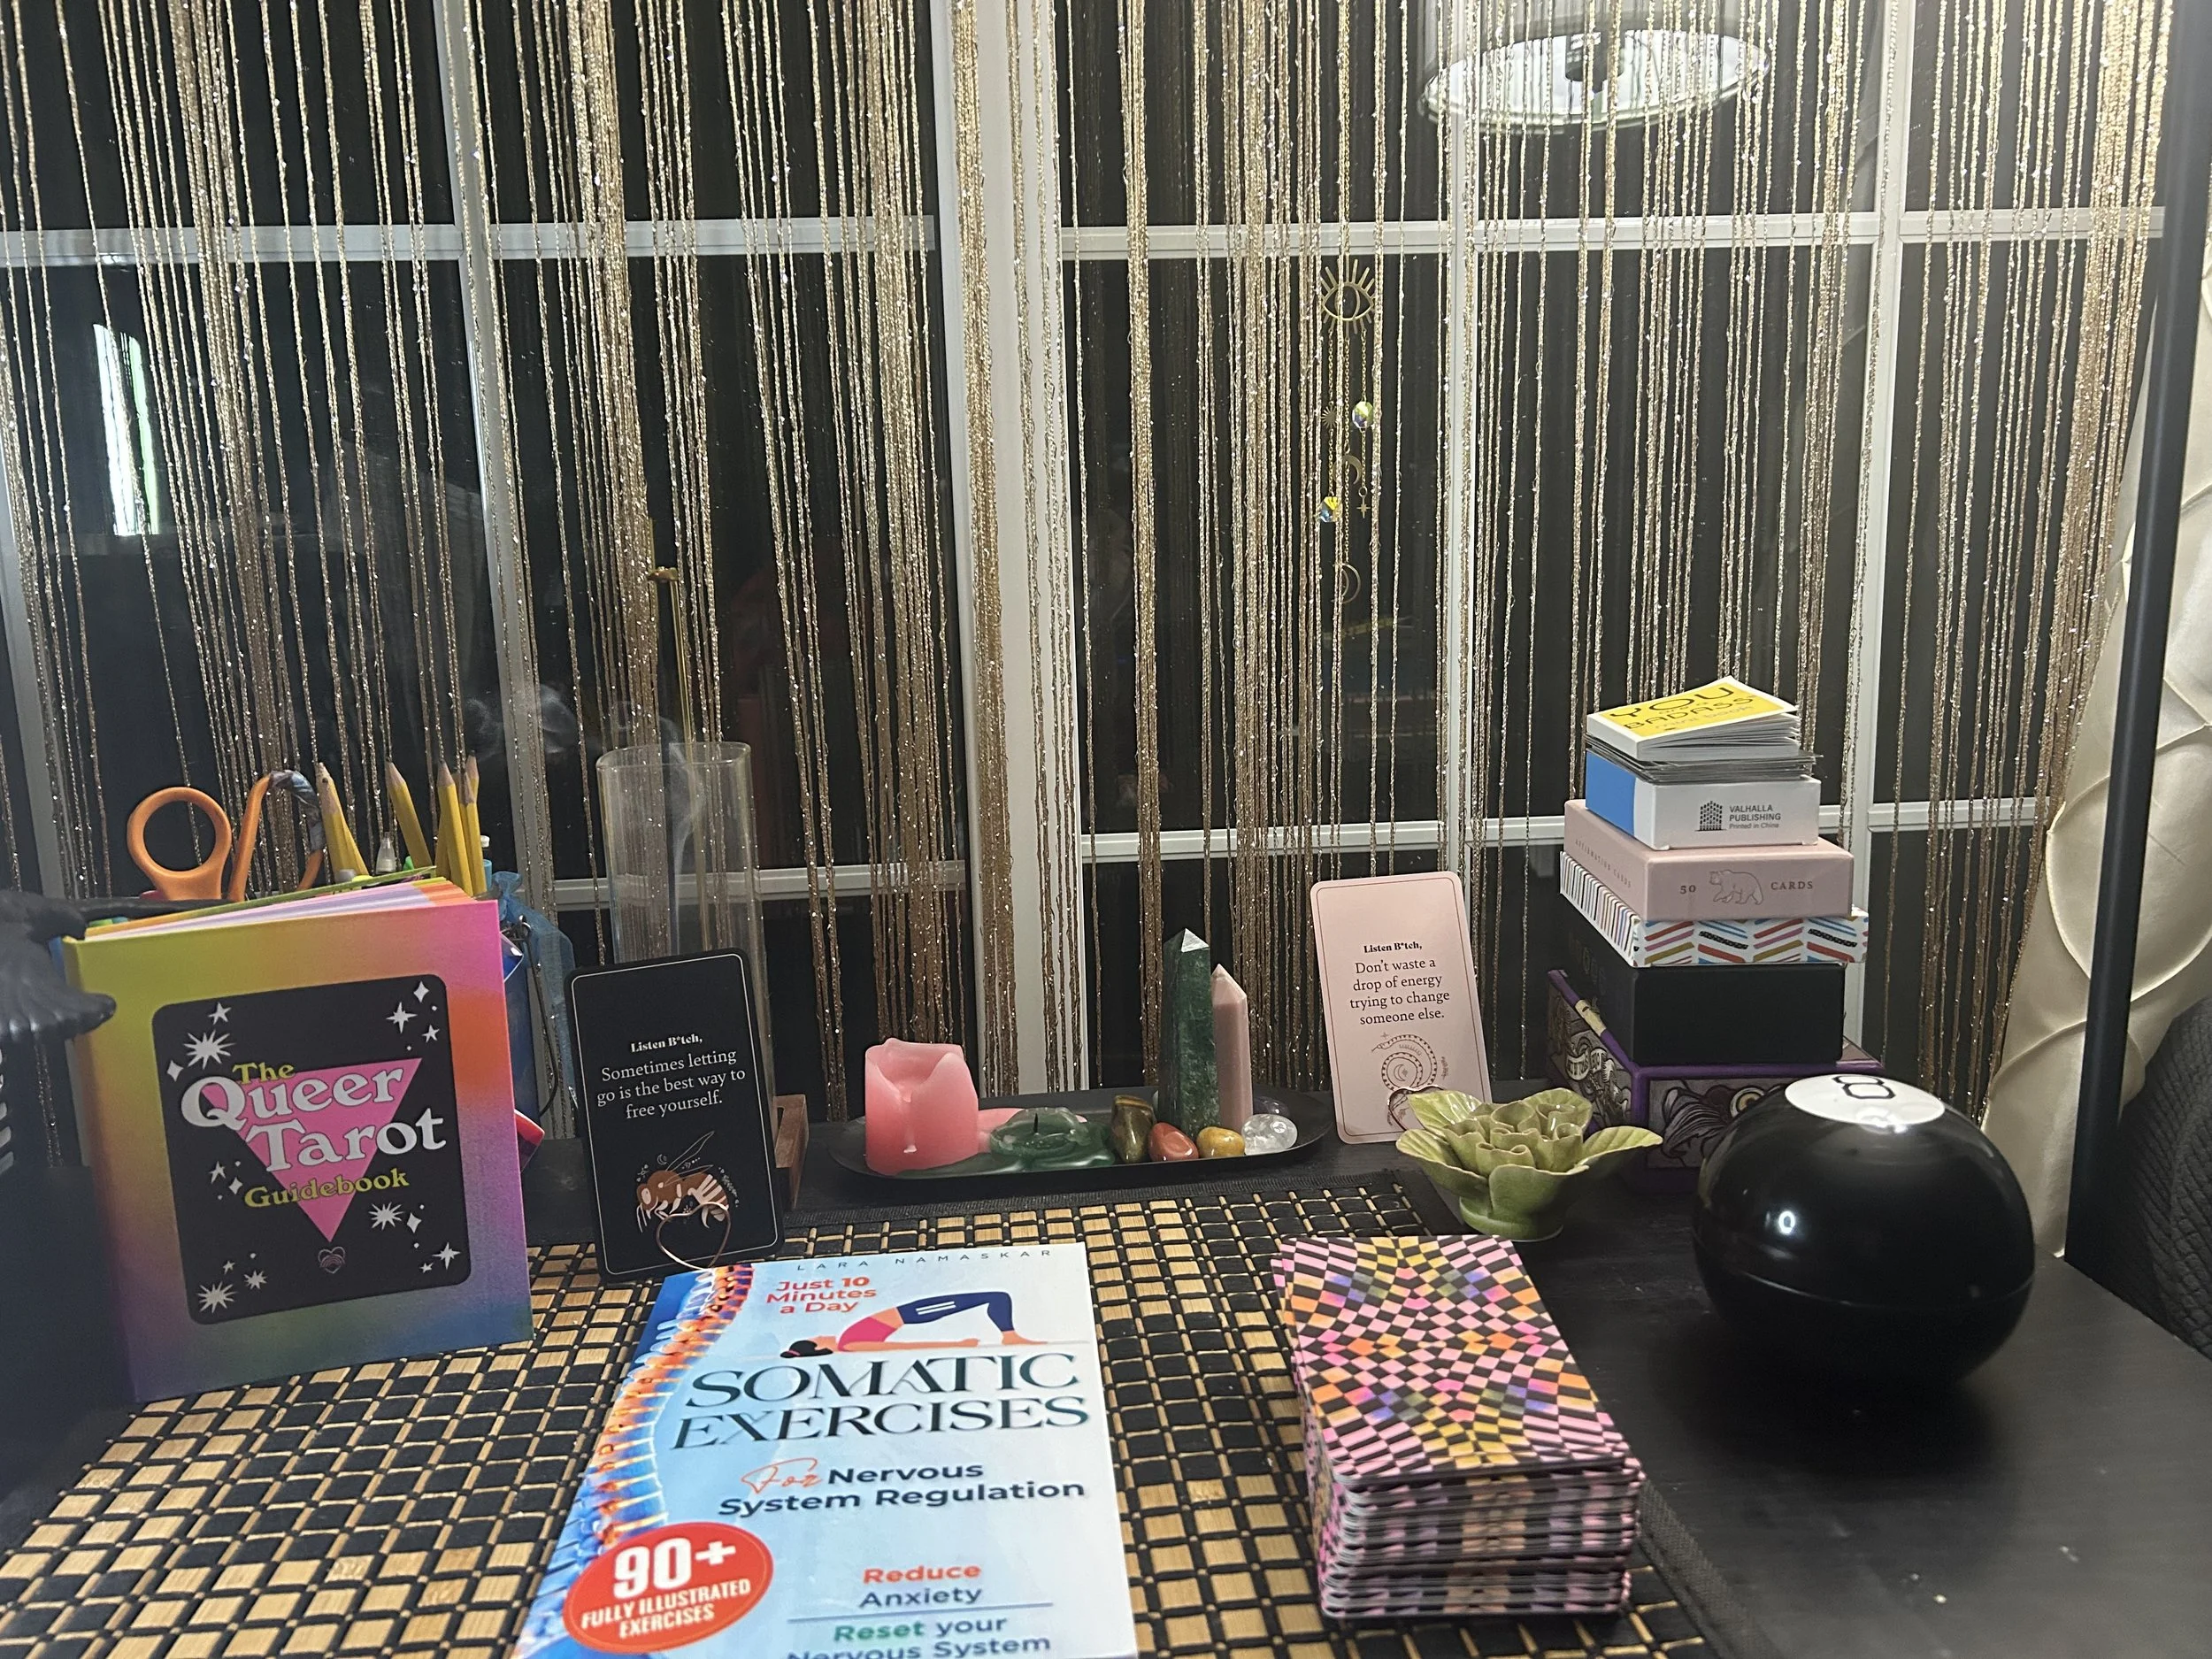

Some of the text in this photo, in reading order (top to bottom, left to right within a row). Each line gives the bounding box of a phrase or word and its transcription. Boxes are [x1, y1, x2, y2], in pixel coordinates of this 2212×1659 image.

[1610, 687, 1734, 717] YOU
[1729, 804, 1773, 813] VALHALLA
[1729, 813, 1781, 822] PUBLISHING
[1770, 880, 1813, 891] CARDS
[1363, 944, 1392, 954] Listen
[1355, 959, 1436, 974] Don't waste a
[1353, 975, 1442, 993] drop of energy
[1350, 991, 1450, 1011] trying to change
[1360, 1007, 1445, 1025] someone else.
[630, 1040, 665, 1053] Listen
[232, 1062, 296, 1085] The
[602, 1050, 737, 1081] Sometimes letting
[597, 1069, 746, 1107] go is the best way to
[1832, 1074, 1895, 1099] 8
[180, 1067, 403, 1131] Queer
[626, 1089, 723, 1119] free yourself.
[245, 1107, 446, 1172] Tarot
[243, 1167, 410, 1208] Guidebook
[797, 1249, 1051, 1271] LARA NAMASKAR
[776, 1276, 871, 1292] Just 10
[765, 1289, 878, 1303] Minutes
[780, 1301, 859, 1314] a Day
[685, 1352, 1079, 1409] SOMATIC
[669, 1395, 1090, 1451] EXERCISES
[740, 1457, 985, 1494] For Nervous
[718, 1480, 1086, 1518] System Regulation
[612, 1537, 736, 1600] 90+
[862, 1564, 983, 1585] Reduce
[580, 1578, 752, 1630] FULLY ILLUSTRATED
[858, 1586, 983, 1609] Anxiety
[618, 1603, 716, 1640] EXERCISES
[833, 1617, 1008, 1641] Reset your
[933, 1637, 1051, 1659] System
